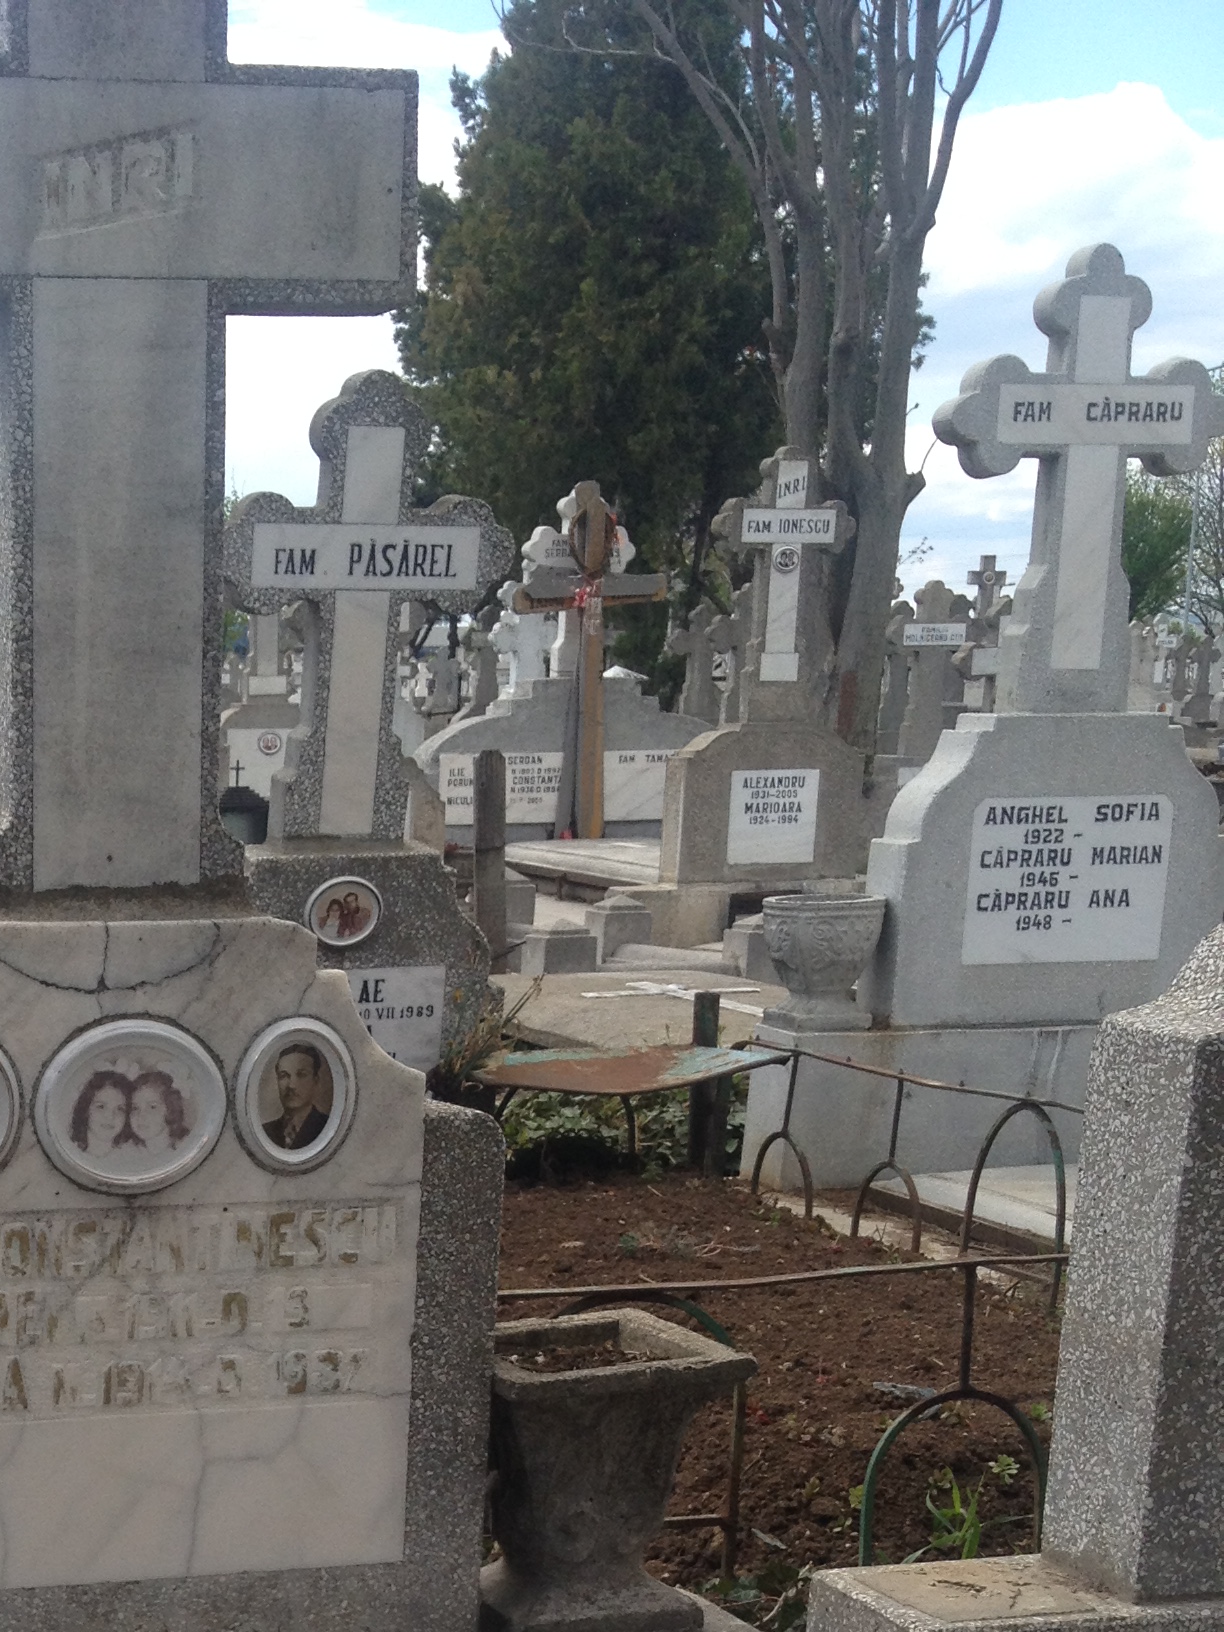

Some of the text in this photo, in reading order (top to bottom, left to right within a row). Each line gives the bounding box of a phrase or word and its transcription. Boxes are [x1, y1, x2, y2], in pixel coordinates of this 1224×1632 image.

[1013, 402, 1052, 422] FAM
[778, 476, 806, 499] INRI
[778, 518, 830, 534] IONESCU
[743, 776, 806, 789] ALEXANDRU
[744, 801, 802, 815] MARIOARA
[983, 801, 1161, 826] ANGHEL SOFIA
[1023, 828, 1065, 845] 1922
[1091, 845, 1164, 866] MARIAN
[1019, 871, 1060, 888] 1946
[1088, 888, 1131, 909] ANA
[1015, 914, 1053, 931] 1948
[399, 1004, 434, 1019] 1989
